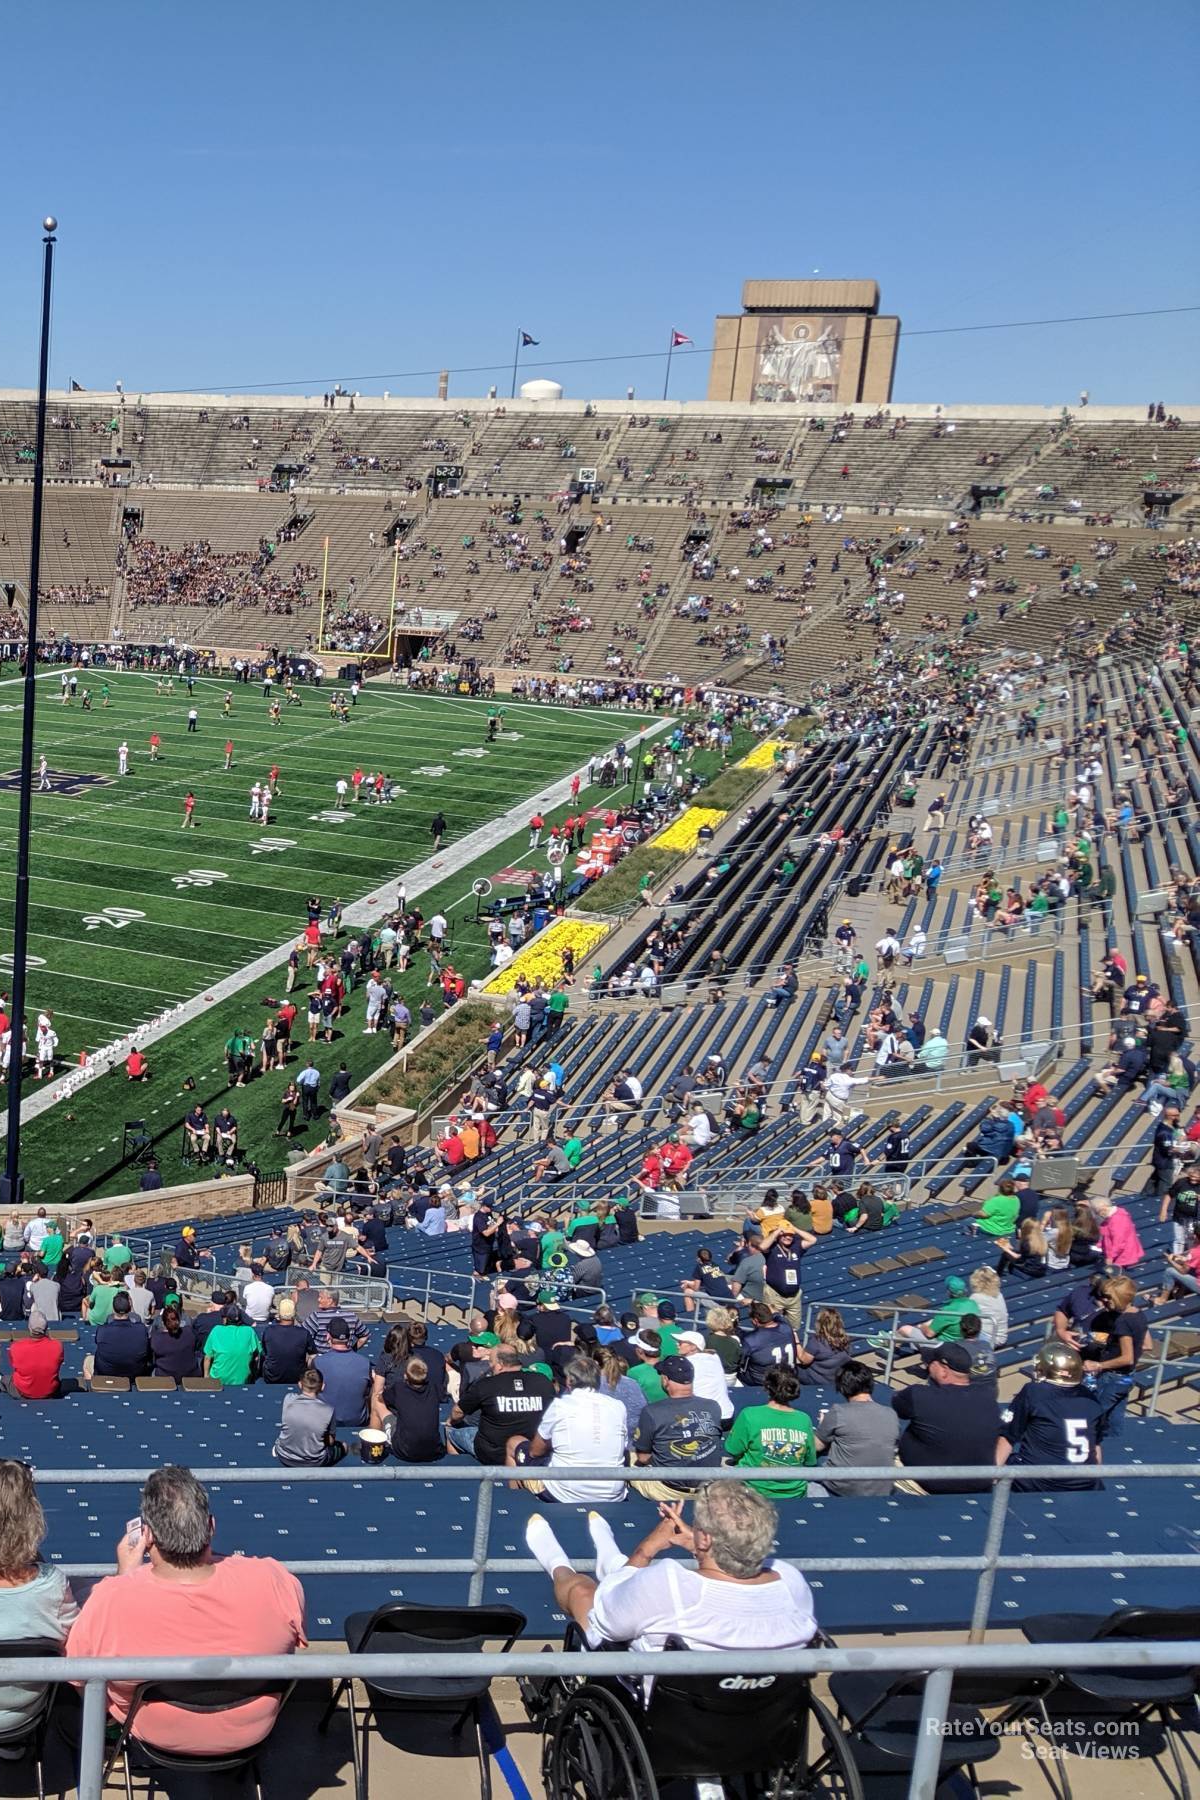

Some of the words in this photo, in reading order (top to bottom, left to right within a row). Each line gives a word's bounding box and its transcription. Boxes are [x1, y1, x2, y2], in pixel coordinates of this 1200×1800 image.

[171, 869, 228, 887] 30
[81, 906, 146, 928] 20
[772, 1343, 795, 1369] 11
[496, 1396, 543, 1413] VETERAN
[760, 1427, 788, 1442] NOTRE
[1064, 1418, 1089, 1463] 5
[718, 1675, 778, 1690] drive
